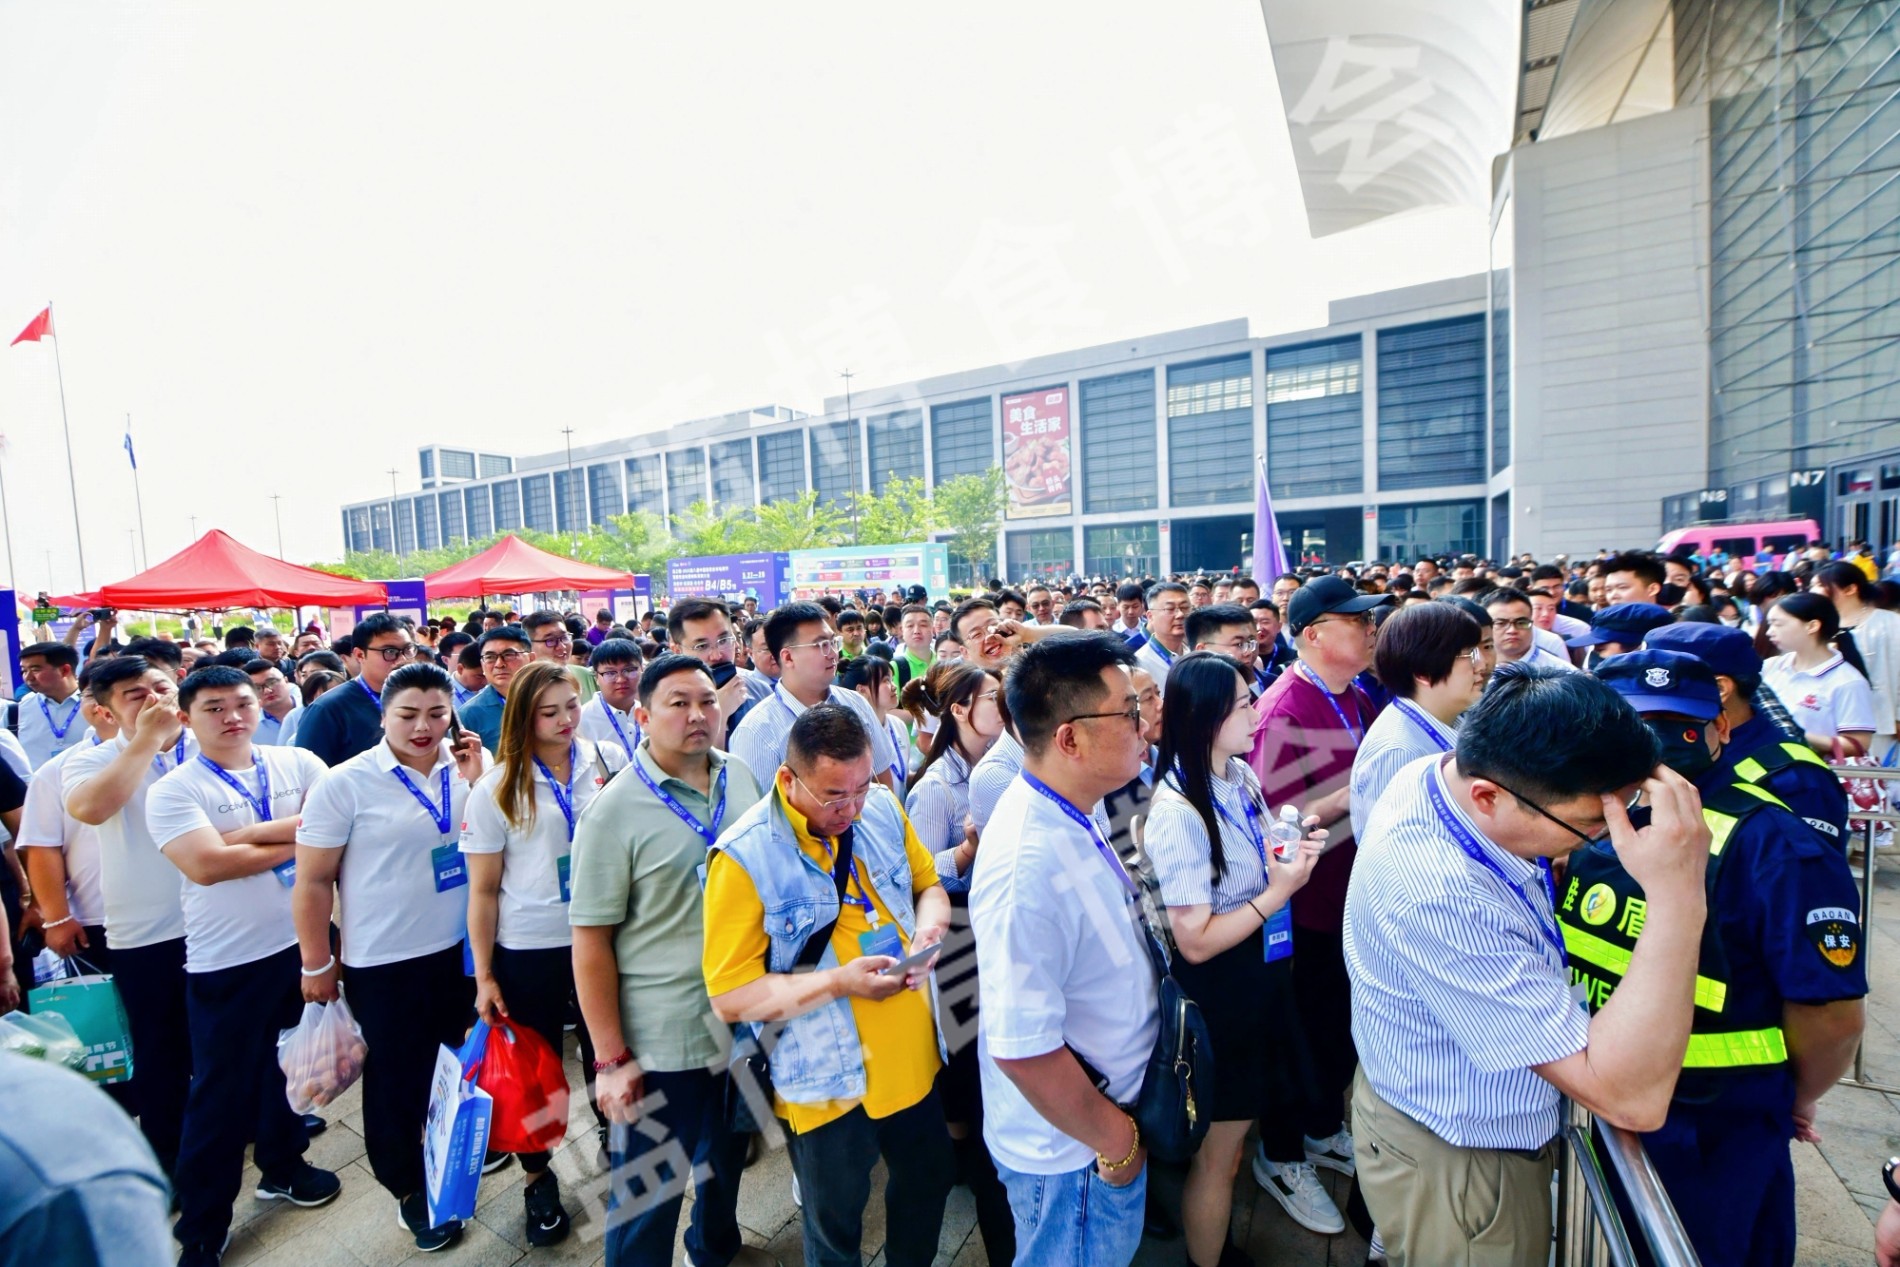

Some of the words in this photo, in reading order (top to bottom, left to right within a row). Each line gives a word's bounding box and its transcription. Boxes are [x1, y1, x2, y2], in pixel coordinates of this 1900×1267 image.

[1020, 416, 1062, 436] 生活家
[1790, 469, 1826, 487] N7
[273, 787, 301, 800] Jeans
[1812, 908, 1851, 921] BAOAN
[1824, 934, 1851, 948] 保安
